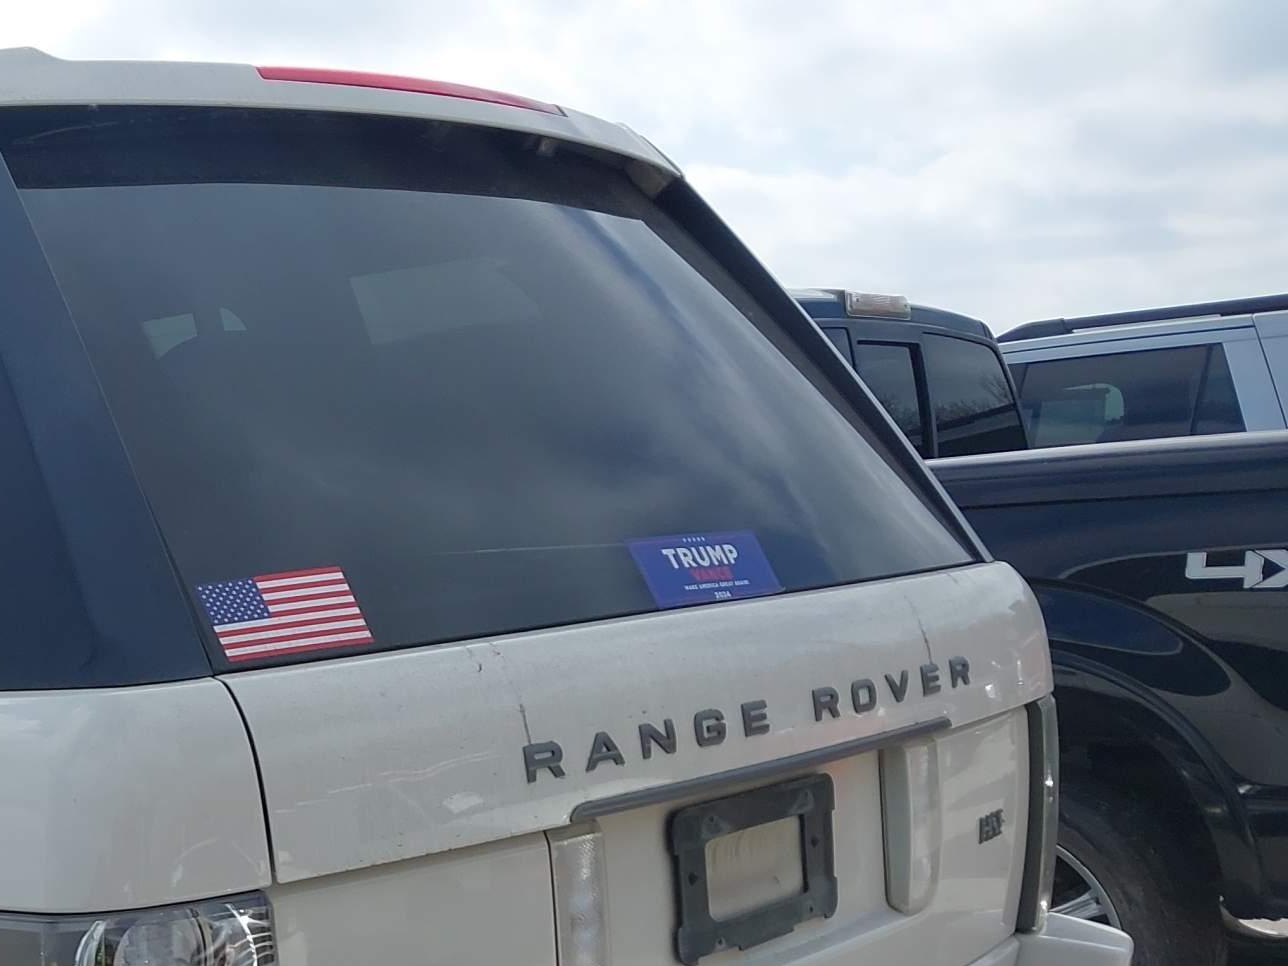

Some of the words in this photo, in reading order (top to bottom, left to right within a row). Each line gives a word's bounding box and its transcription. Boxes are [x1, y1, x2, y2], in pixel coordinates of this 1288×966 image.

[661, 544, 738, 569] TRUMP
[689, 567, 734, 581] VANCE
[523, 700, 771, 784] RANGE
[812, 656, 971, 722] ROVER
